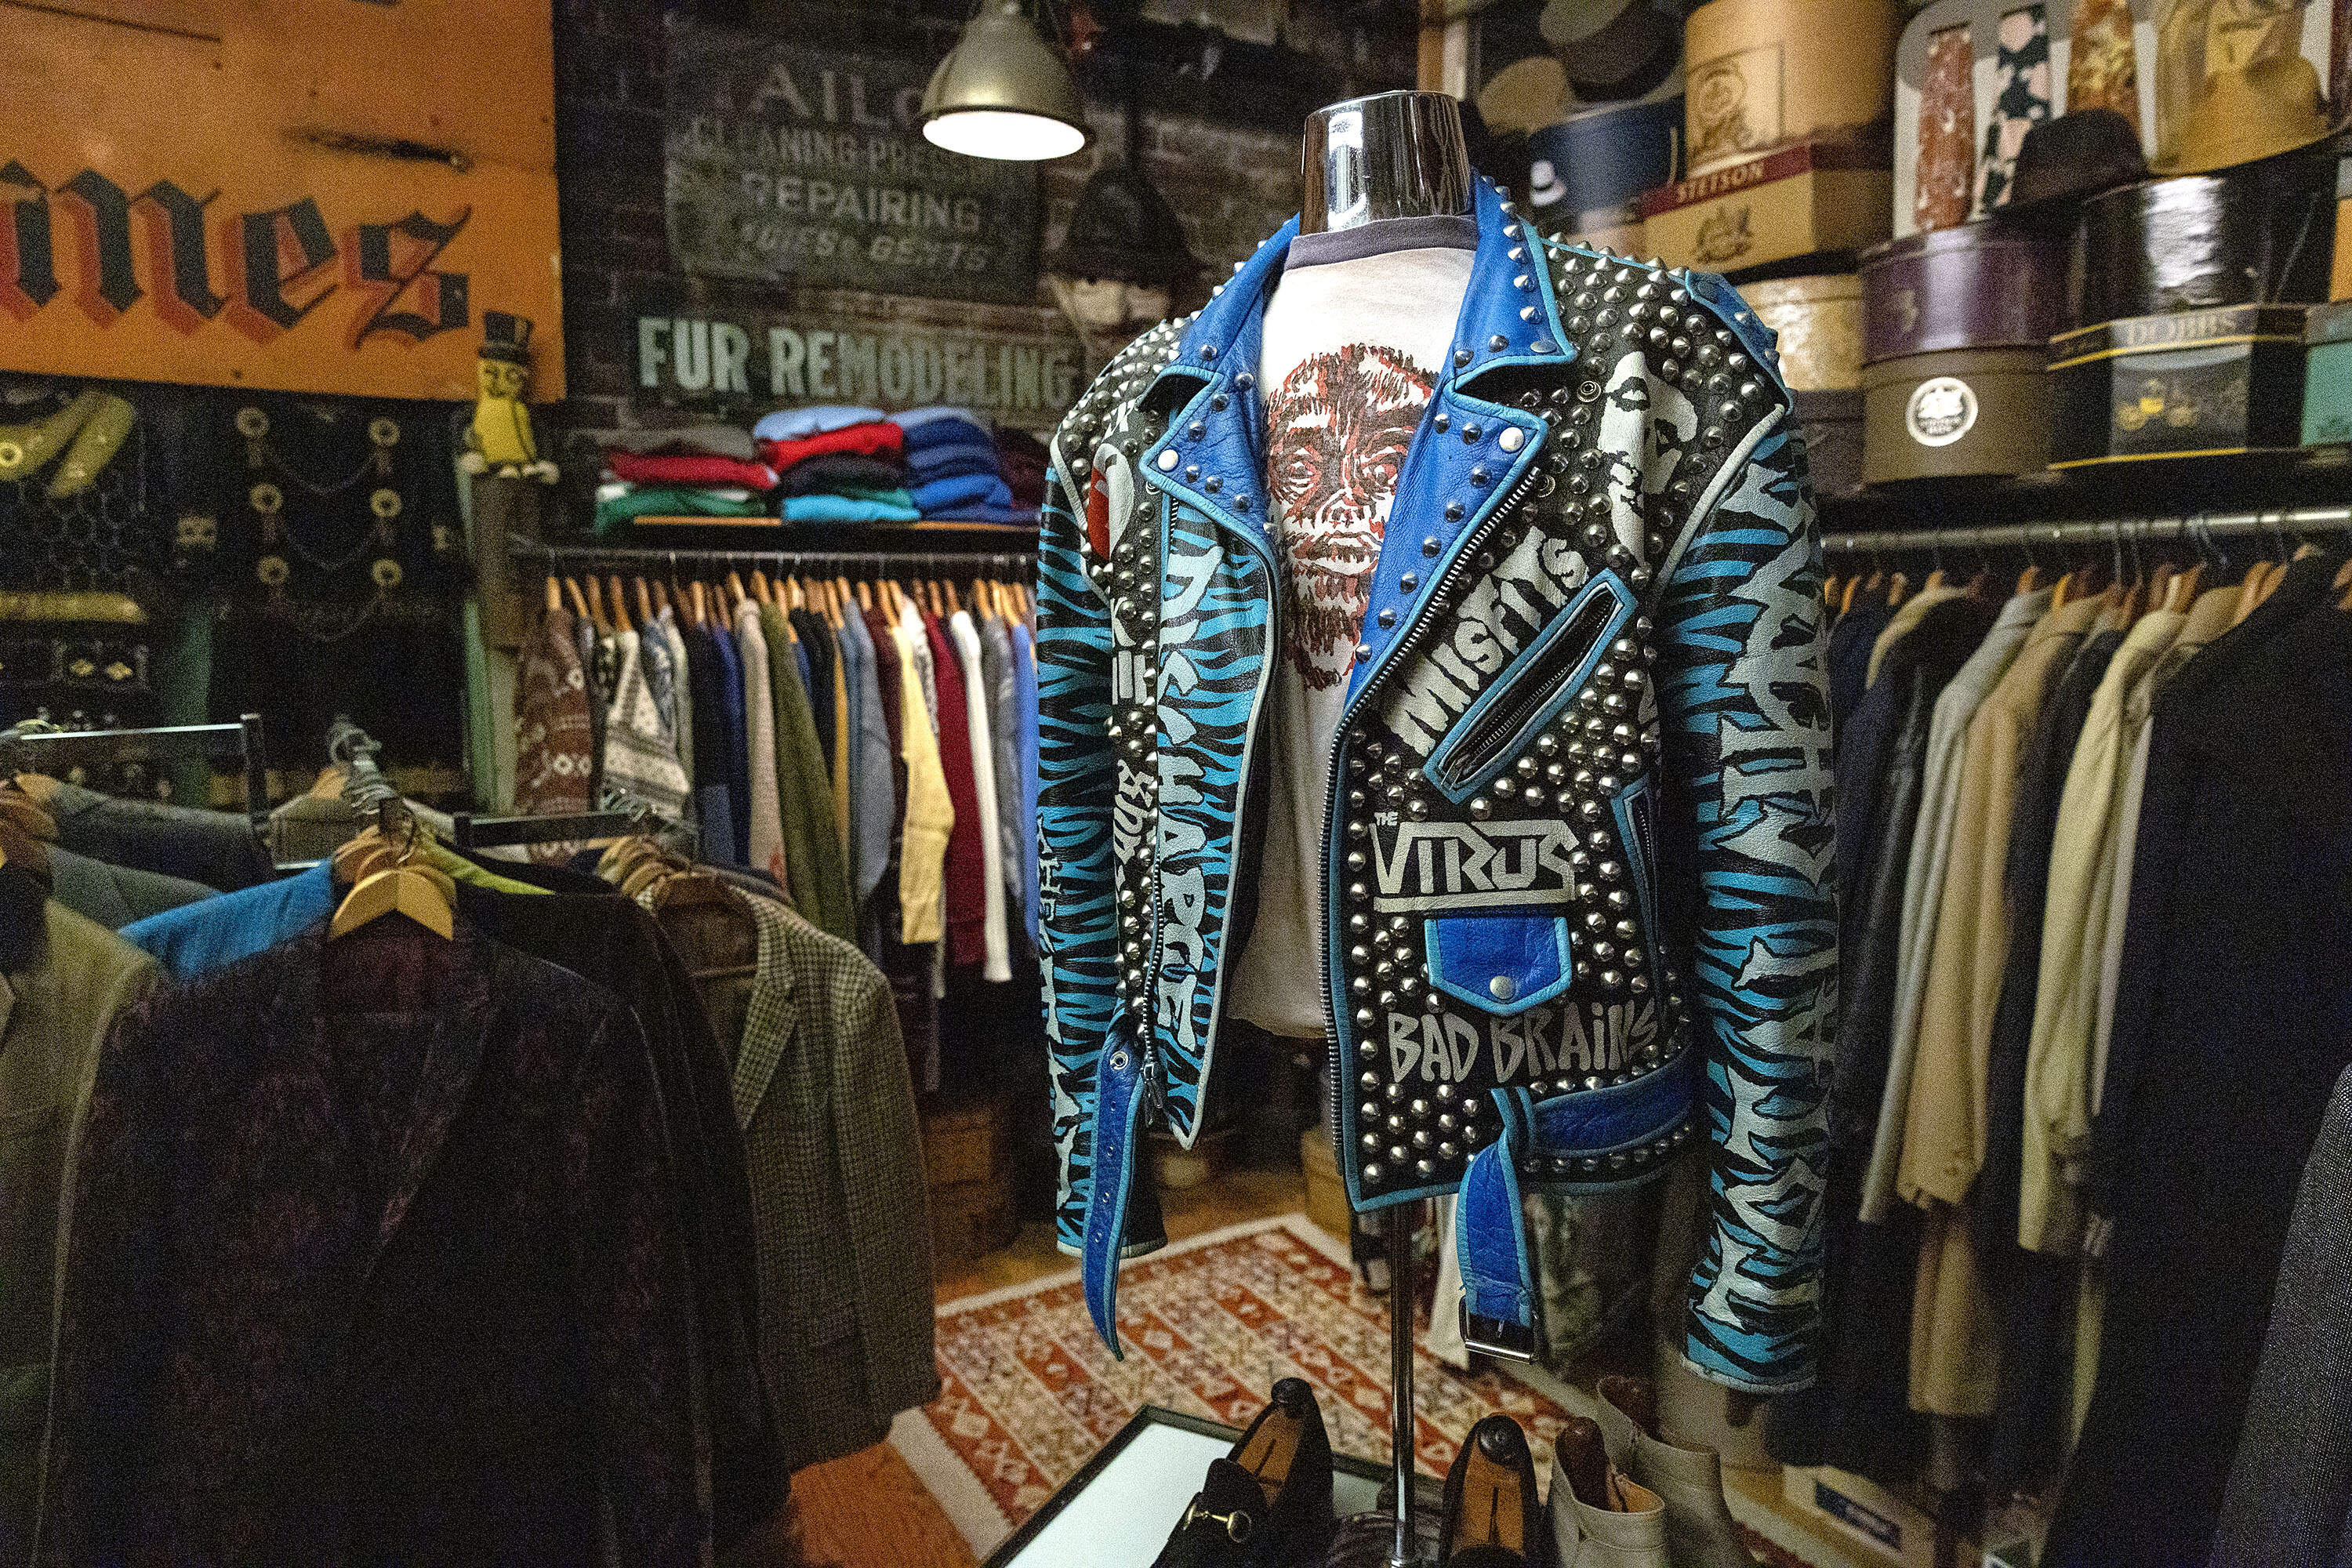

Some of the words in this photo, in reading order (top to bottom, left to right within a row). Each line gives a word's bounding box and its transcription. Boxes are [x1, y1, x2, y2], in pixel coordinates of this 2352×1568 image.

[1676, 162, 1766, 202] STETSON
[637, 317, 752, 393] FUR
[769, 326, 1071, 408] REMODELING
[1381, 525, 1589, 757] MISFITS
[1156, 546, 1225, 1053] DISCHARGE
[1374, 811, 1399, 826] THE
[1370, 820, 1579, 902] VIRUS
[1388, 1012, 1480, 1083] BAD
